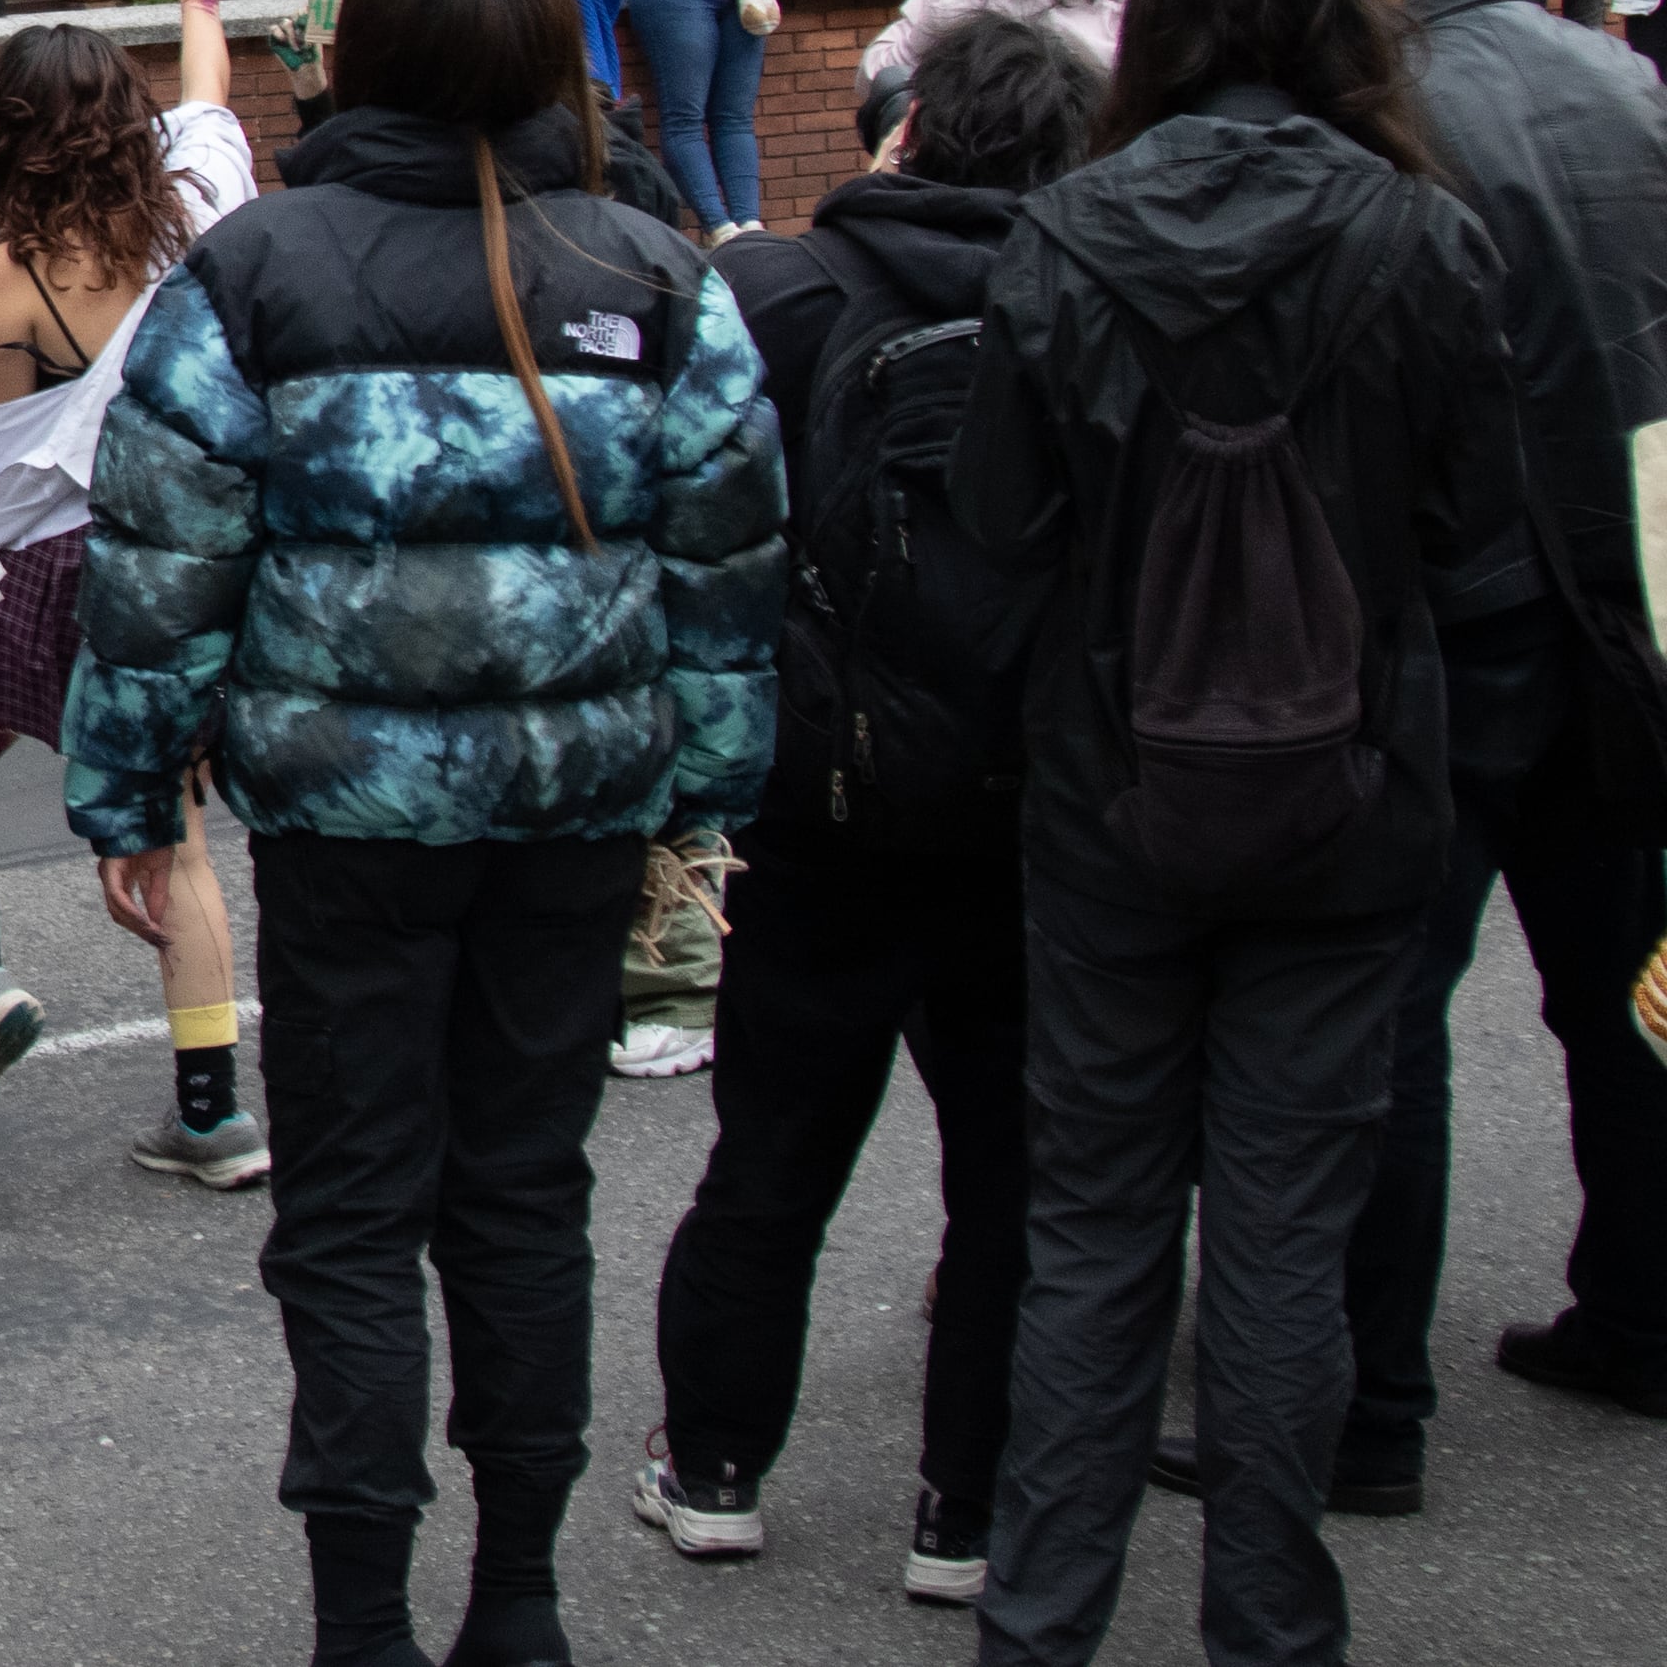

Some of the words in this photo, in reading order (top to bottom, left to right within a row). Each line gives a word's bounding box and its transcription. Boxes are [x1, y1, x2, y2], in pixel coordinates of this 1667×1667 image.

[590, 313, 620, 327] THE
[563, 322, 617, 342] NORTH
[579, 339, 616, 354] FACE
